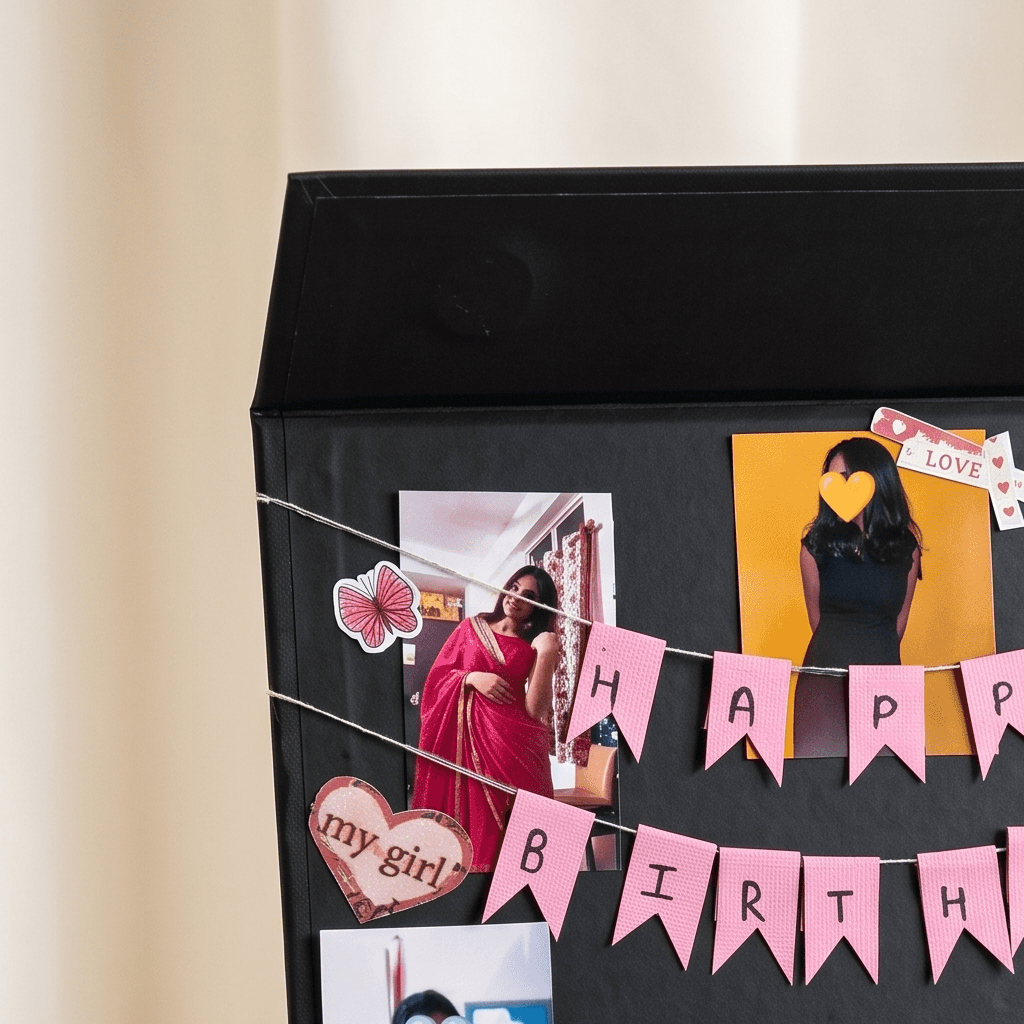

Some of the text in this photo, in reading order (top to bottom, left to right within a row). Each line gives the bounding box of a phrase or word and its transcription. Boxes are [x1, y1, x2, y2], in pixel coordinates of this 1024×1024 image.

[926, 449, 982, 478] LOVE
[317, 813, 447, 889] my girl
